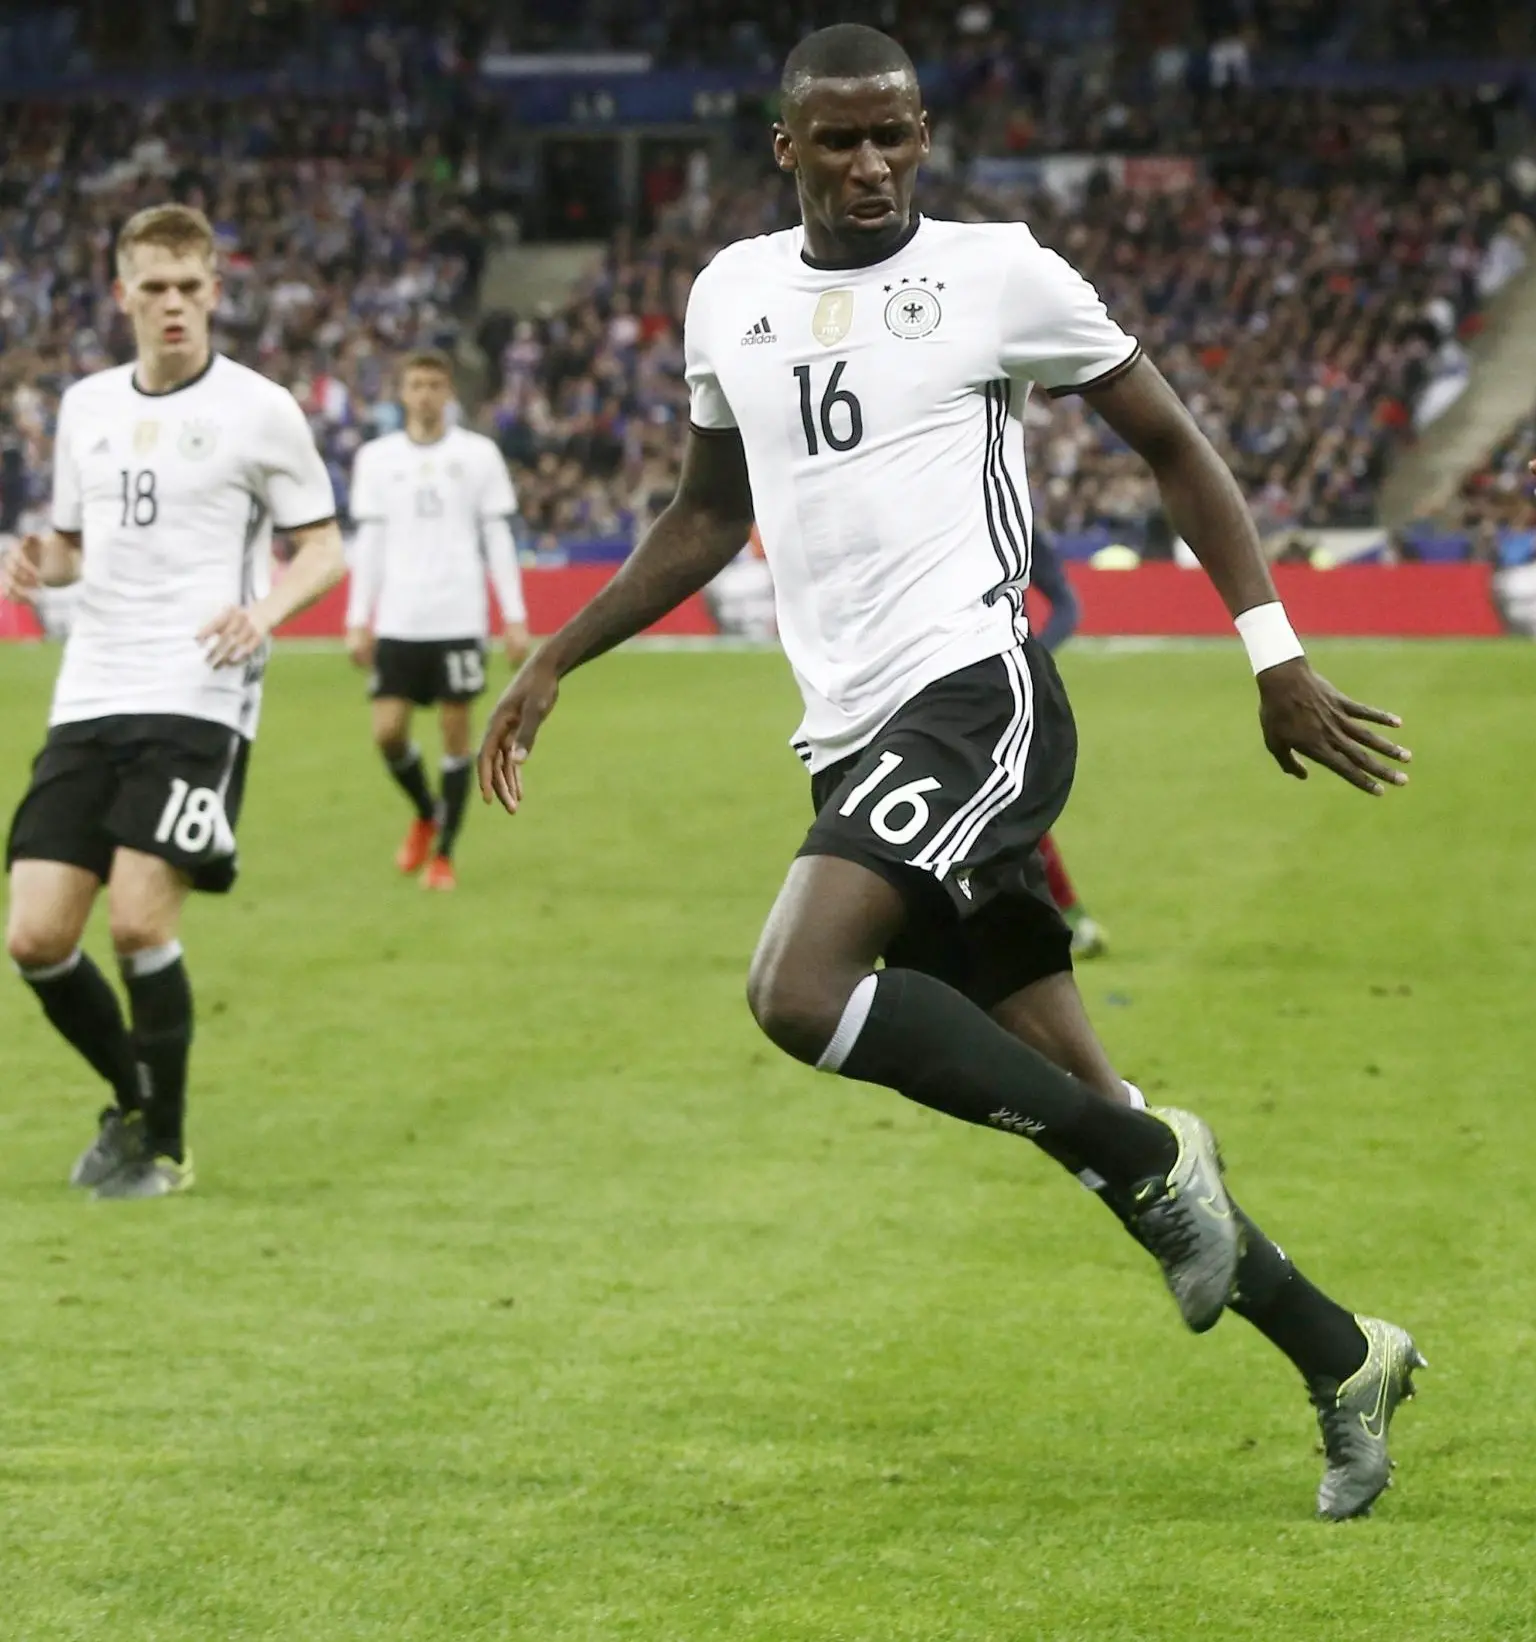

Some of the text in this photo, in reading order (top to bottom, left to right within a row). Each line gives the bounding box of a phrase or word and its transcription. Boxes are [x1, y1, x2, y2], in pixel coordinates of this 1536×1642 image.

[740, 334, 778, 346] adidas
[793, 360, 864, 456] 16
[119, 468, 157, 527] 18
[445, 651, 485, 693] 13
[154, 776, 219, 853] 18
[838, 750, 943, 845] 16
